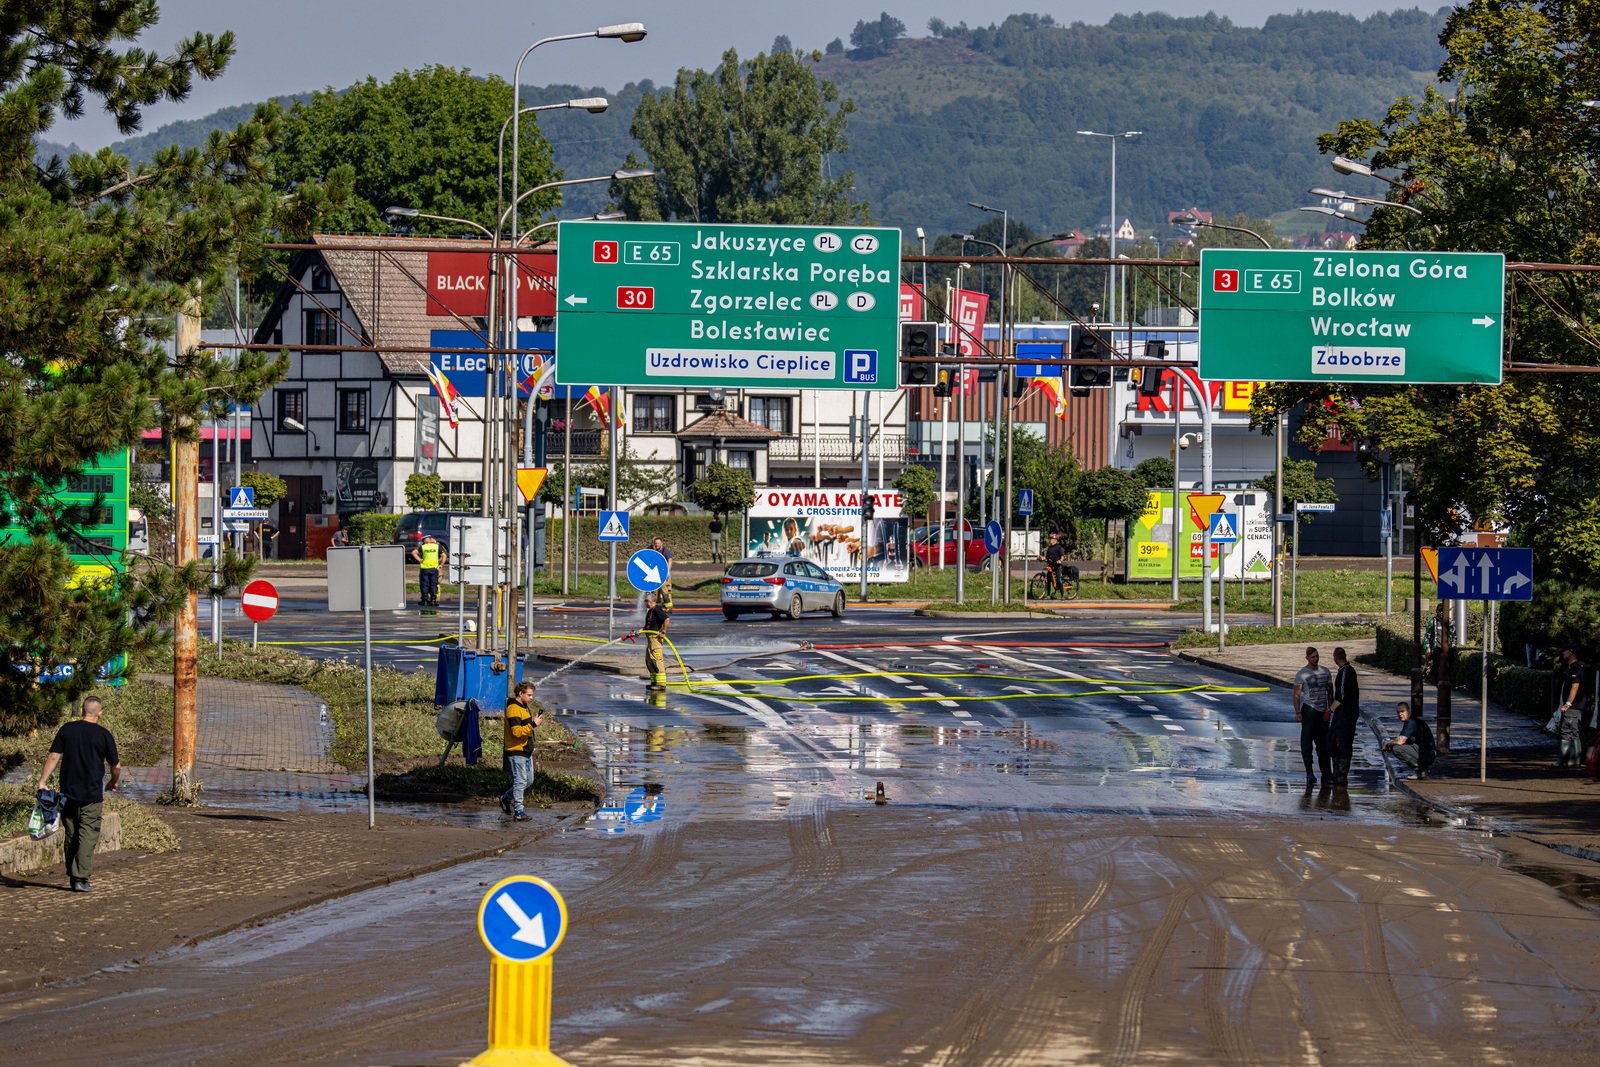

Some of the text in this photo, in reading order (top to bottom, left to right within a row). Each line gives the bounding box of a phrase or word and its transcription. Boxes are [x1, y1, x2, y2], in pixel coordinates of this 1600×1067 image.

[691, 230, 806, 257] Jakuszyce
[819, 236, 835, 249] PL
[854, 238, 873, 251] CZ
[600, 245, 611, 260] 3
[633, 246, 672, 261] E 65
[691, 260, 891, 288] Szklarska Poręba
[1313, 257, 1468, 280] Zielona Góra
[437, 275, 486, 291] BLACK
[526, 275, 557, 291] WHI
[1220, 272, 1232, 288] 3
[1253, 273, 1293, 289] E 65
[624, 290, 647, 306] 30
[690, 289, 802, 315] Zgorzelec
[816, 294, 832, 307] PL
[856, 295, 867, 308] D
[1312, 286, 1396, 308] Bolków
[691, 319, 830, 342] Bolesławiec
[1311, 315, 1412, 337] Wrocław
[650, 352, 831, 374] Uzdrowisko Cieplice
[851, 353, 871, 379] P
[1316, 350, 1401, 367] Zabobrze
[859, 373, 876, 382] BUS
[768, 493, 903, 507] OYAMA KAATE
[806, 507, 863, 516] CROSSFITNE
